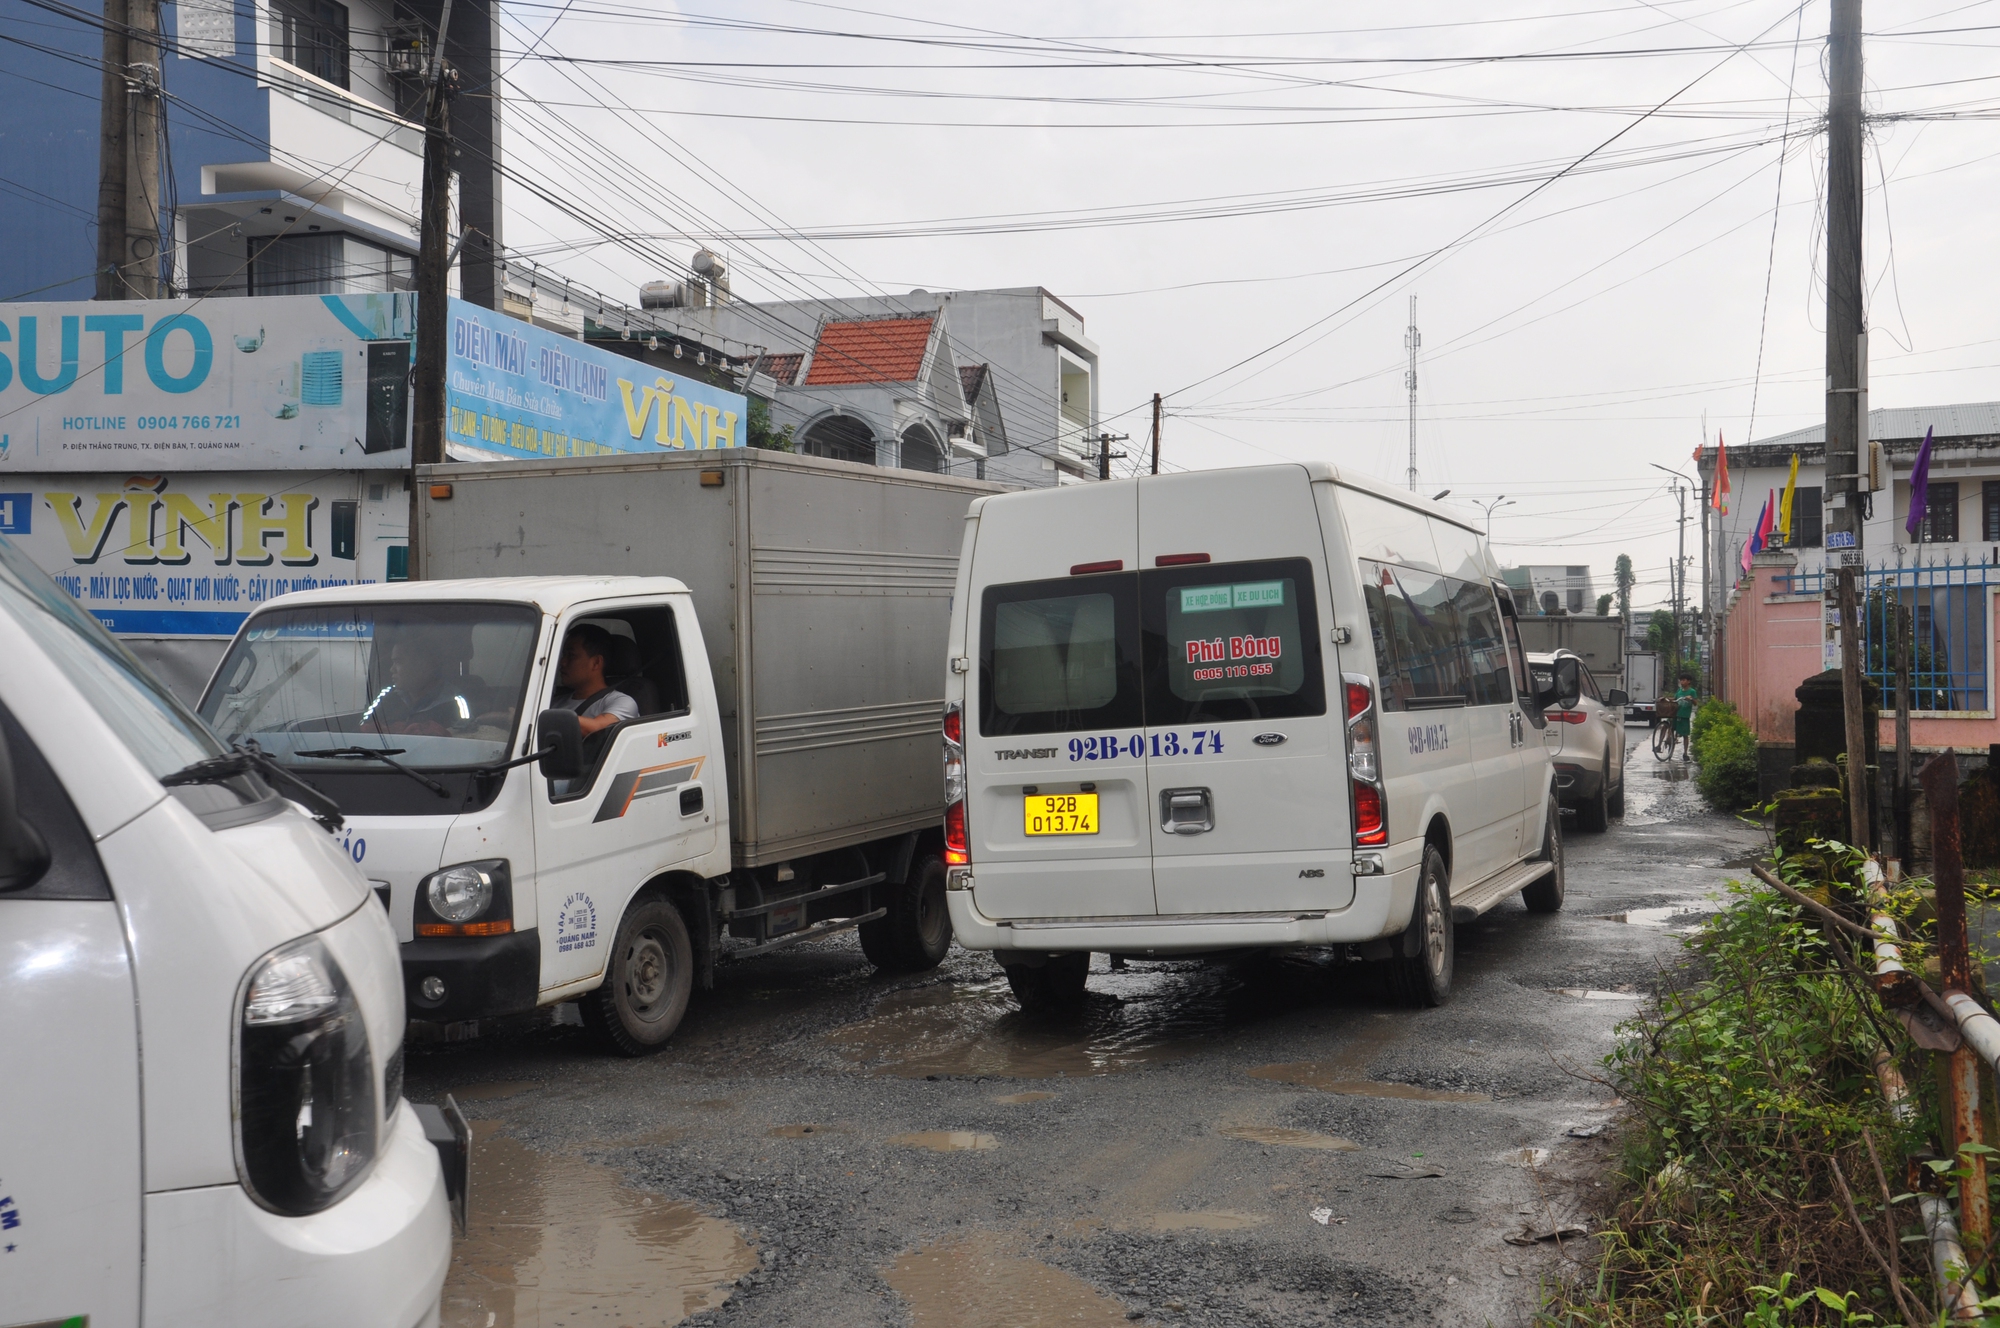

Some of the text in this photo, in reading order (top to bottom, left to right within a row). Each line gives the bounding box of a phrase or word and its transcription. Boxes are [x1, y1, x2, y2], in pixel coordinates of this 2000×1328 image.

[0, 314, 214, 395] UTO
[454, 315, 491, 370] ĐIỆN
[494, 329, 528, 378] MÁY
[539, 344, 571, 395] ĐIỆN
[574, 358, 608, 403] LẠNH
[453, 370, 486, 396] Chuyên
[487, 380, 504, 402] Mua
[507, 386, 522, 407] Bán
[63, 415, 241, 430] HOTLINE 0904 766 721
[617, 377, 739, 450] VĨNH
[70, 442, 87, 451] ĐIỆN
[113, 443, 140, 451] TRUNG,
[153, 442, 171, 450] ĐIỆN
[44, 475, 319, 567] VĨNH
[90, 572, 110, 599] MÁY
[113, 577, 130, 604] LỌC
[133, 573, 158, 600] NƯỚC
[167, 577, 192, 606] QUẠT
[194, 576, 211, 601] HƠI
[213, 574, 239, 602] NƯỚC
[249, 575, 268, 602] CÂY
[1237, 589, 1280, 602] XE DU LỊCH
[1185, 596, 1194, 606] XE
[1186, 635, 1281, 663] Phú Bông
[1194, 663, 1273, 681] 0905 116 955
[995, 730, 1225, 762] TRANSIT 92B-013.74
[1258, 734, 1280, 744] Ford
[1045, 797, 1077, 813] 92B
[1033, 815, 1090, 832] 013.74
[335, 827, 366, 864] ẢO
[1298, 869, 1325, 879] ABS
[581, 931, 595, 941] NAM
